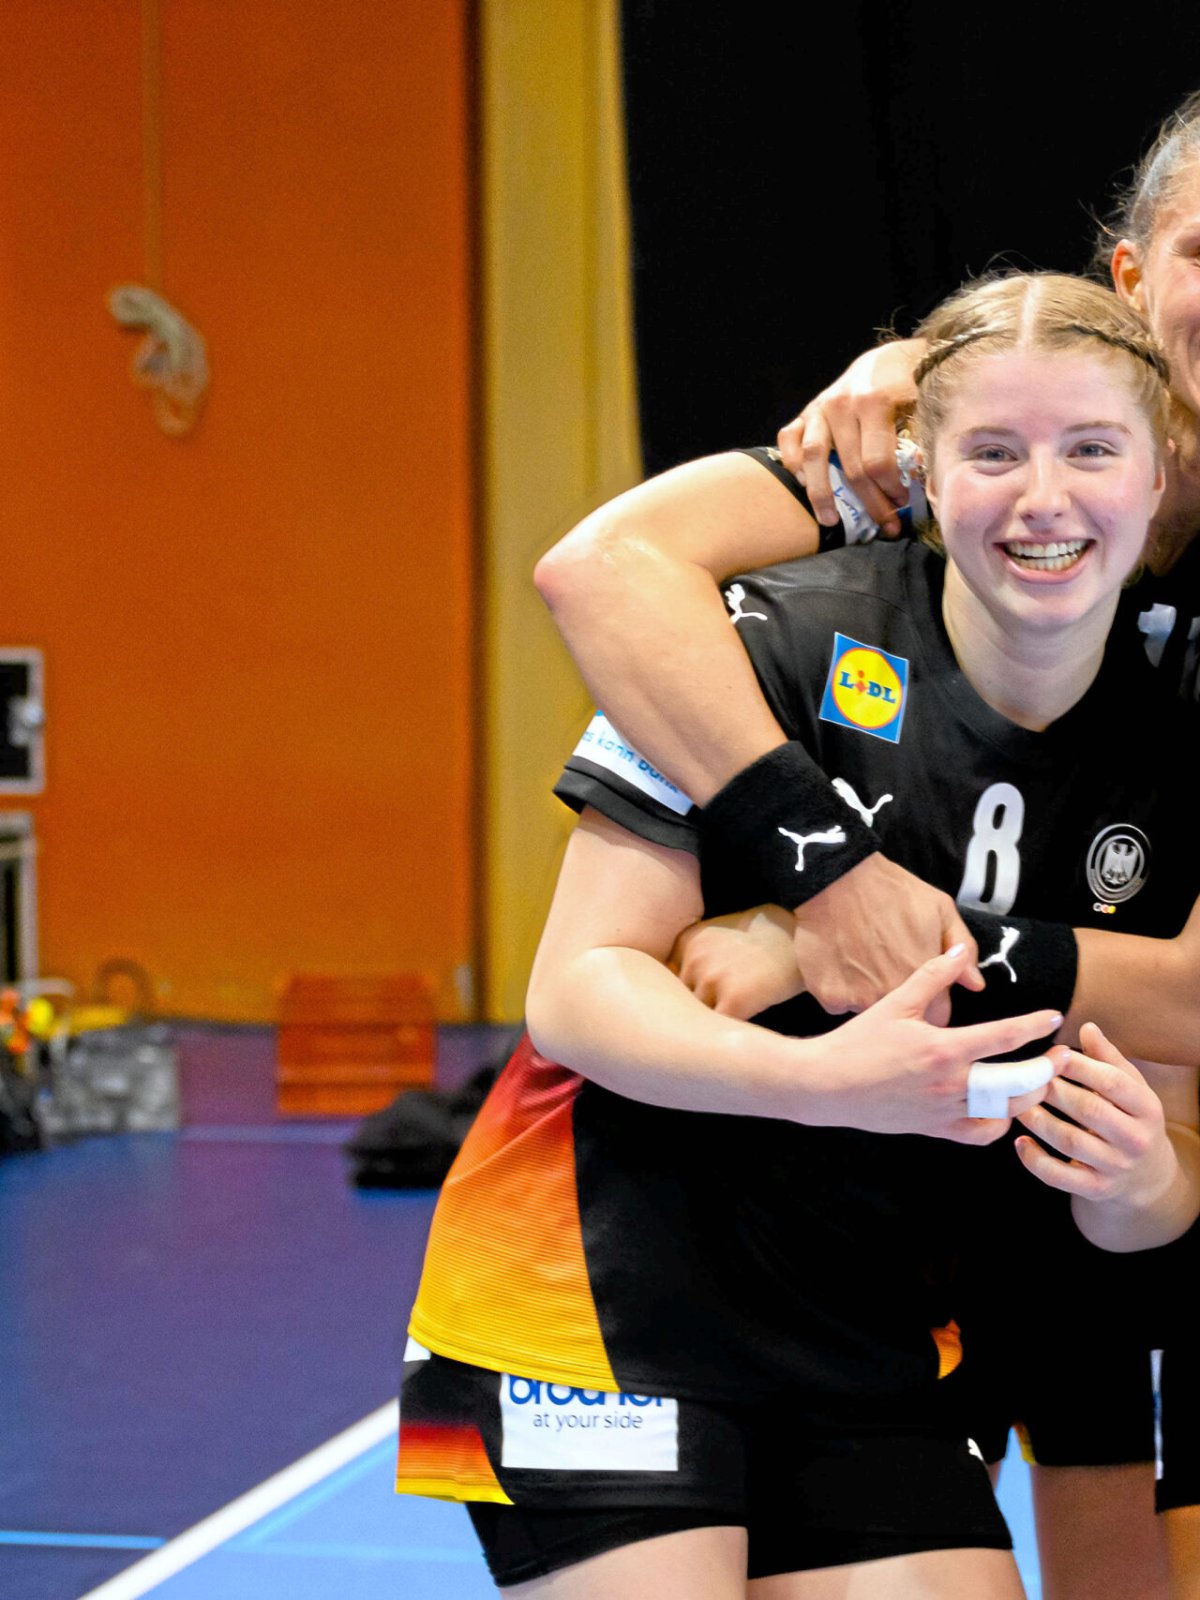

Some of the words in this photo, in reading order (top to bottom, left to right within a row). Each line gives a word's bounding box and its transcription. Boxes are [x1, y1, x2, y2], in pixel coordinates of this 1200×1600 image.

[956, 781, 1026, 916] 8
[533, 1412, 550, 1429] at
[555, 1412, 601, 1433] your
[604, 1410, 644, 1430] side
